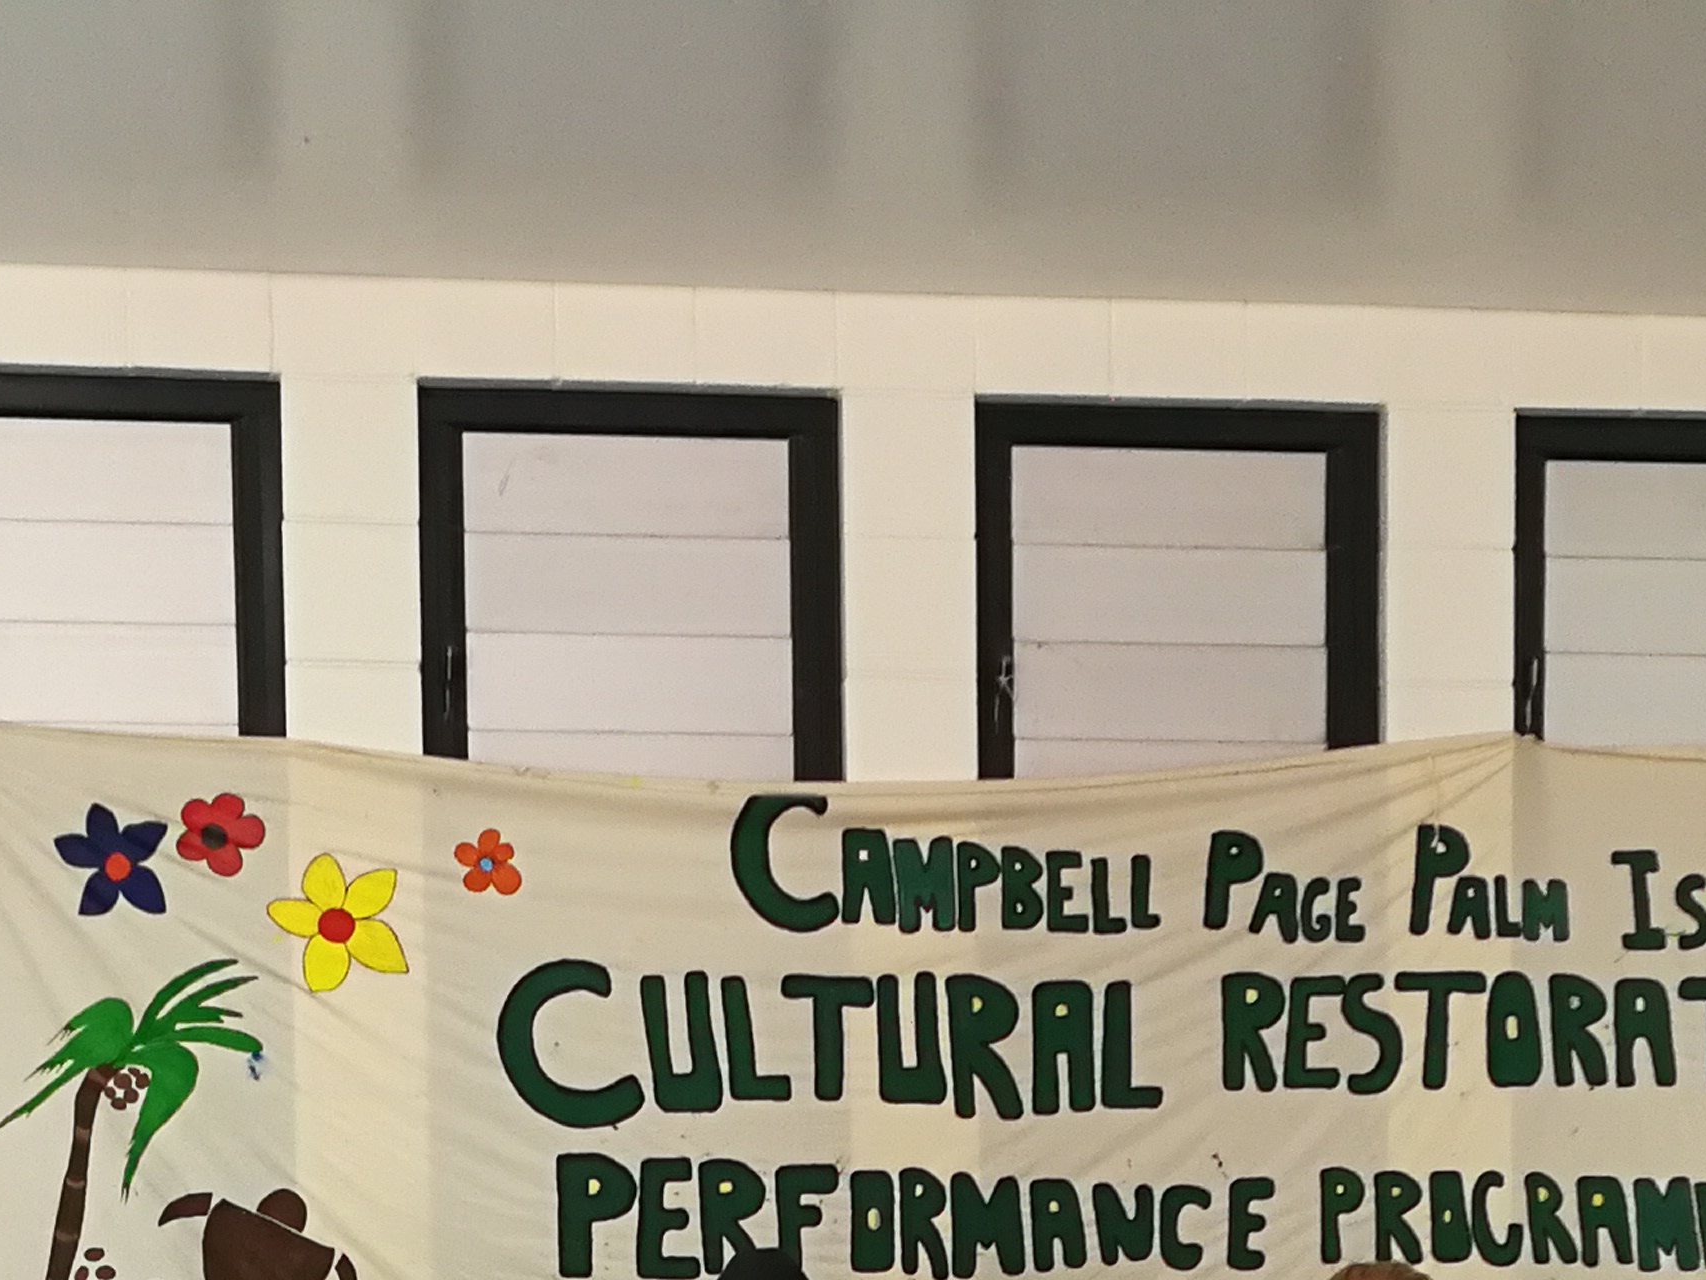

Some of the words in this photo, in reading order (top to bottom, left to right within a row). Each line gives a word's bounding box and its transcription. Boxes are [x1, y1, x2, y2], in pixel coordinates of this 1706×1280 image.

[730, 794, 1163, 936] CAMPBELL
[1202, 830, 1367, 945] PAGE
[1409, 823, 1571, 942] PALM
[496, 958, 1165, 1130] CULTURAL
